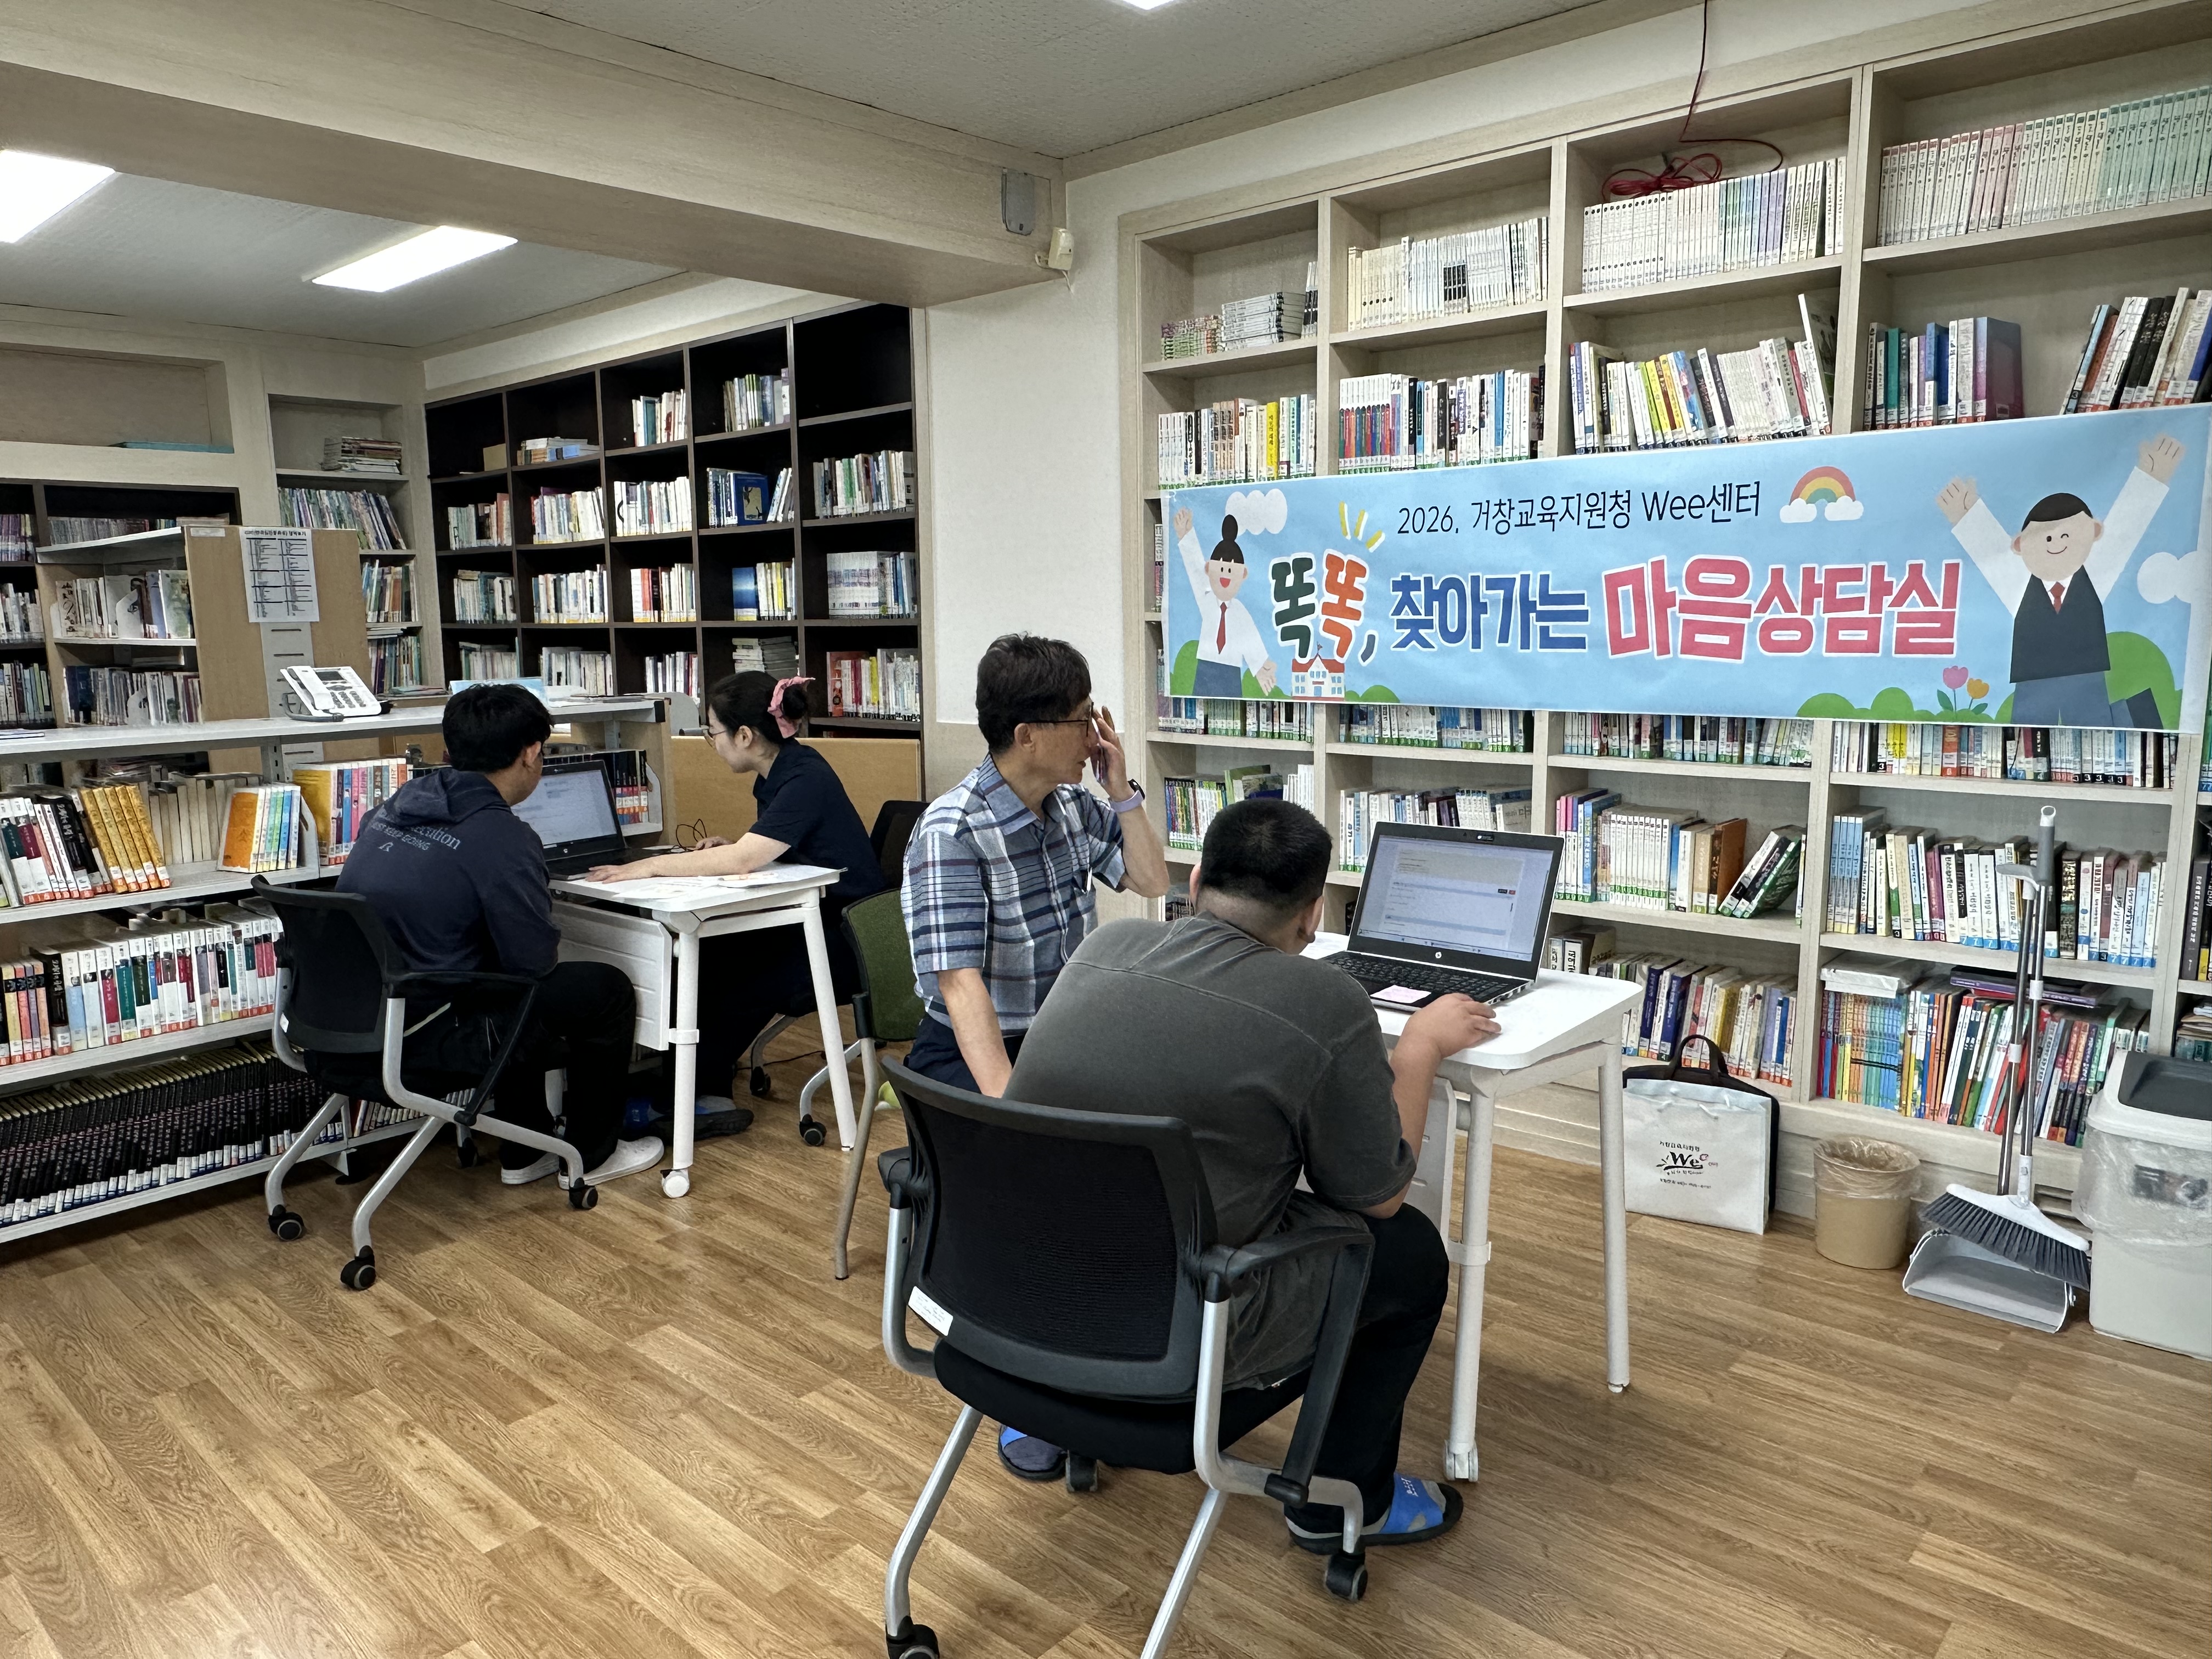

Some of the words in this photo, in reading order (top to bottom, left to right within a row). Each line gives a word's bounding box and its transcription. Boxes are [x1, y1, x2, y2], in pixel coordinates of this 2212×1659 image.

[1397, 505, 1459, 534] 2026.
[1471, 489, 1631, 535] 거창교육지원청
[1641, 481, 1760, 523] Wee센터
[1271, 552, 1376, 663] 똑똑,
[1390, 573, 1589, 650] 찾아가는
[1604, 557, 1961, 660] 마음상담실
